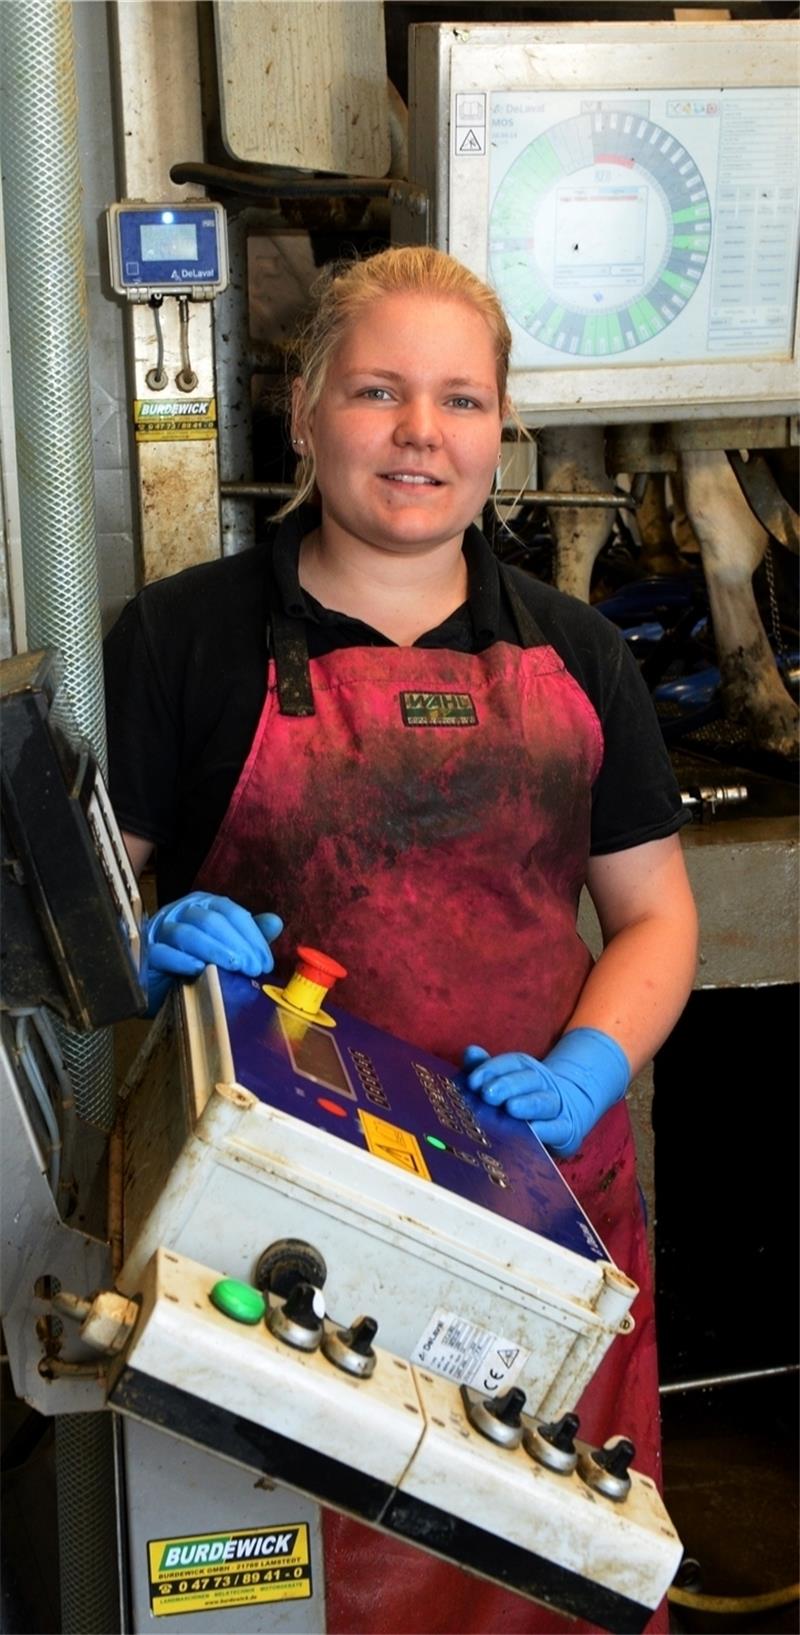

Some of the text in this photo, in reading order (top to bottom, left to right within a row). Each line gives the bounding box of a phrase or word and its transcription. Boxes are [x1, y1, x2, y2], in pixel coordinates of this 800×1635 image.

[492, 118, 514, 128] MOS
[181, 268, 214, 278] DeLaval
[141, 402, 209, 416] BURDEWICK
[165, 1533, 293, 1567] BURDEWICK
[158, 1568, 205, 1579] BURDEWICK
[261, 1557, 301, 1568] LAMSTEDT
[179, 1581, 188, 1592] 0
[191, 1579, 210, 1591] 47
[214, 1576, 231, 1588] 73
[242, 1572, 261, 1584] 89
[264, 1569, 281, 1581] 41
[294, 1567, 303, 1578] 0
